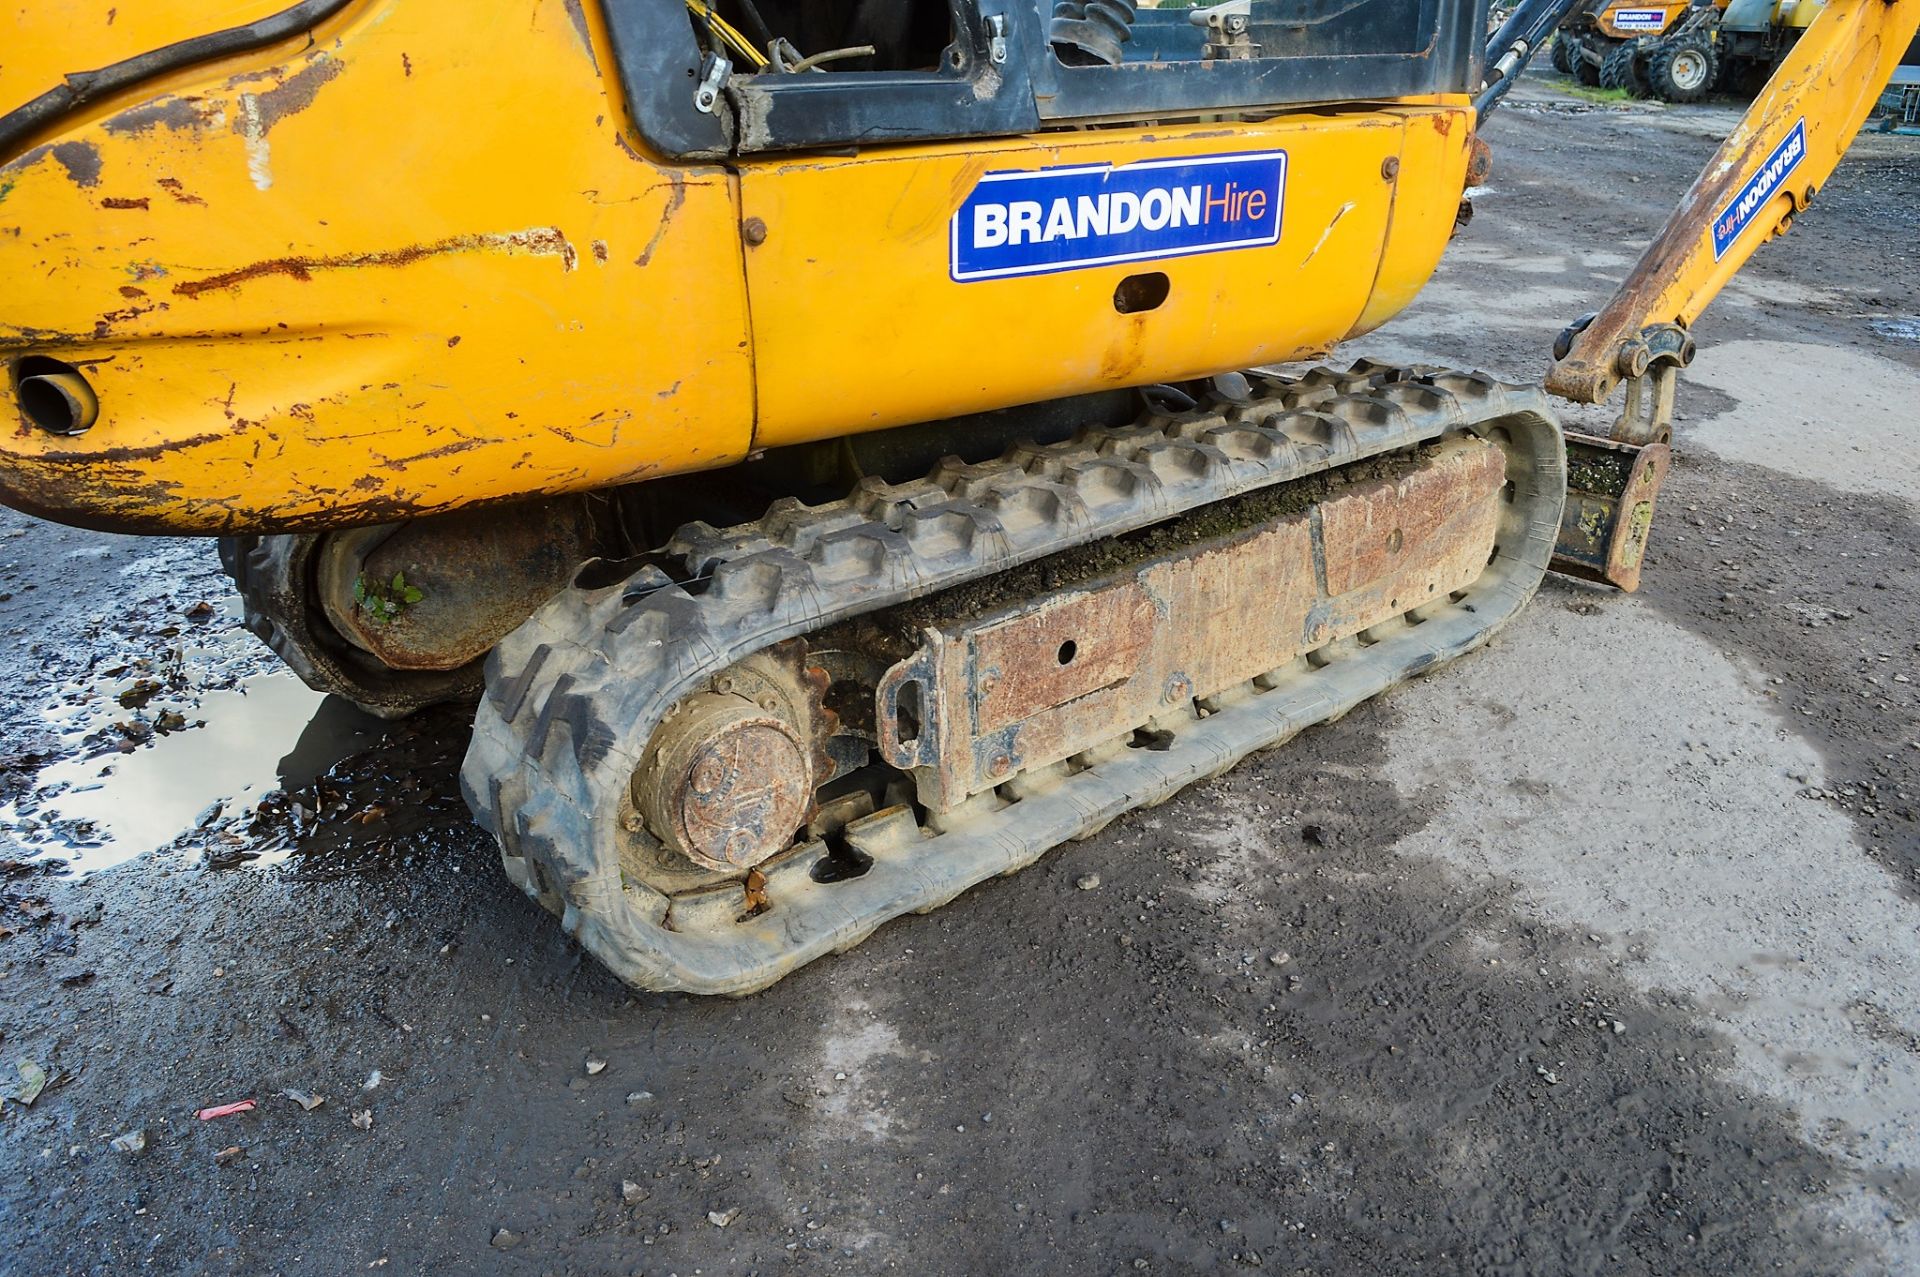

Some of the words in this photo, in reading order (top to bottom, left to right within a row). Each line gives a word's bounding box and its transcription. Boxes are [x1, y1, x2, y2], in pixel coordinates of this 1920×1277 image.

[1738, 133, 1802, 220] BRANDON
[973, 185, 1202, 249] BRANDON
[1204, 182, 1267, 224] Hire
[1717, 206, 1741, 241] Hire
